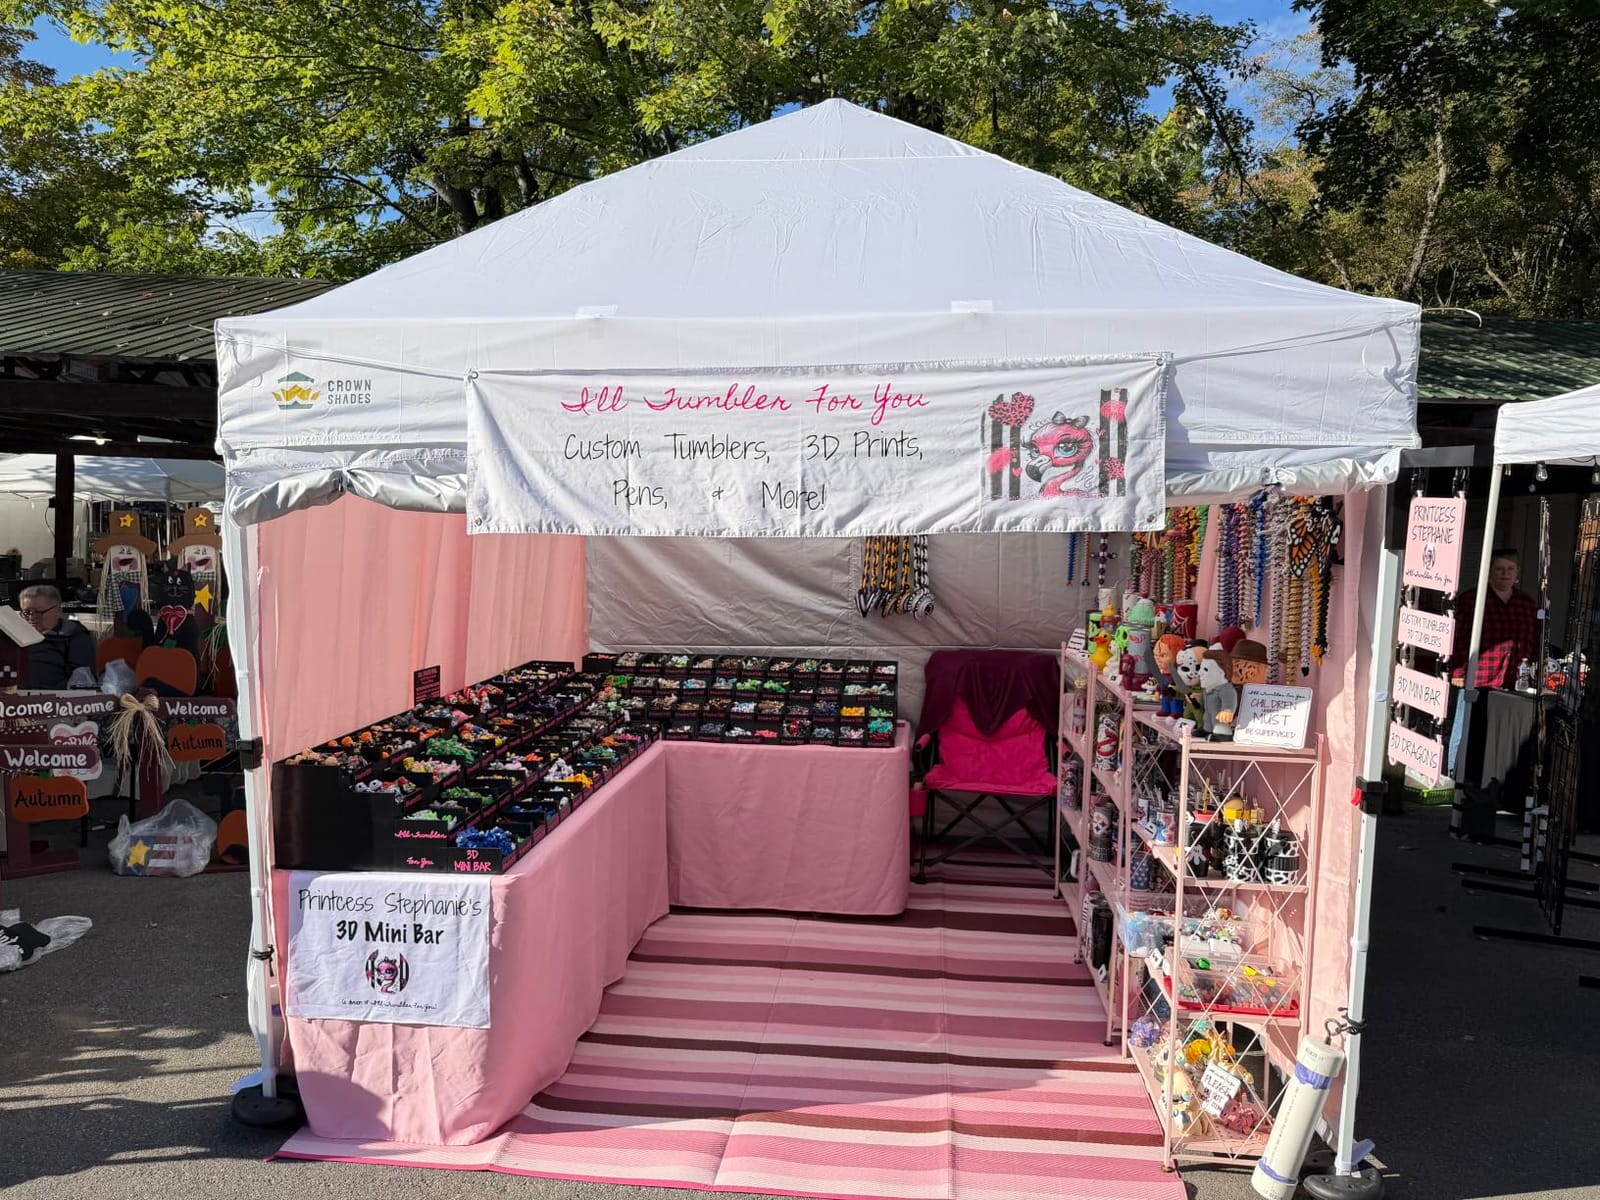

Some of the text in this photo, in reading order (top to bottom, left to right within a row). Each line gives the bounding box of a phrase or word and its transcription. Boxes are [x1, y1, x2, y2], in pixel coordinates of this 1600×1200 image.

[327, 379, 372, 392] CROWN
[327, 393, 372, 405] SHADES
[561, 384, 930, 426] I'll Tumbler For You
[564, 430, 924, 464] Custom Tumblers, 3D Prints,
[613, 480, 669, 510] Pens,
[761, 481, 827, 511] More!
[1413, 505, 1456, 523] PRINTCESS
[1398, 677, 1408, 693] 3D
[1423, 686, 1441, 706] BAR
[55, 701, 114, 717] elcome
[166, 701, 228, 716] Welcome
[1250, 698, 1297, 710] CHILDREN
[1253, 712, 1292, 727] MUST
[170, 736, 223, 751] Autumn
[1390, 732, 1438, 769] 3D DRAGONS
[4, 748, 87, 767] Welcome
[15, 788, 82, 808] Autumn
[466, 849, 479, 860] 3D
[454, 861, 470, 871] MINI
[473, 861, 492, 872] BAR
[298, 888, 483, 921] Printcess Stephanie's
[336, 920, 445, 944] 3D Mini Bar
